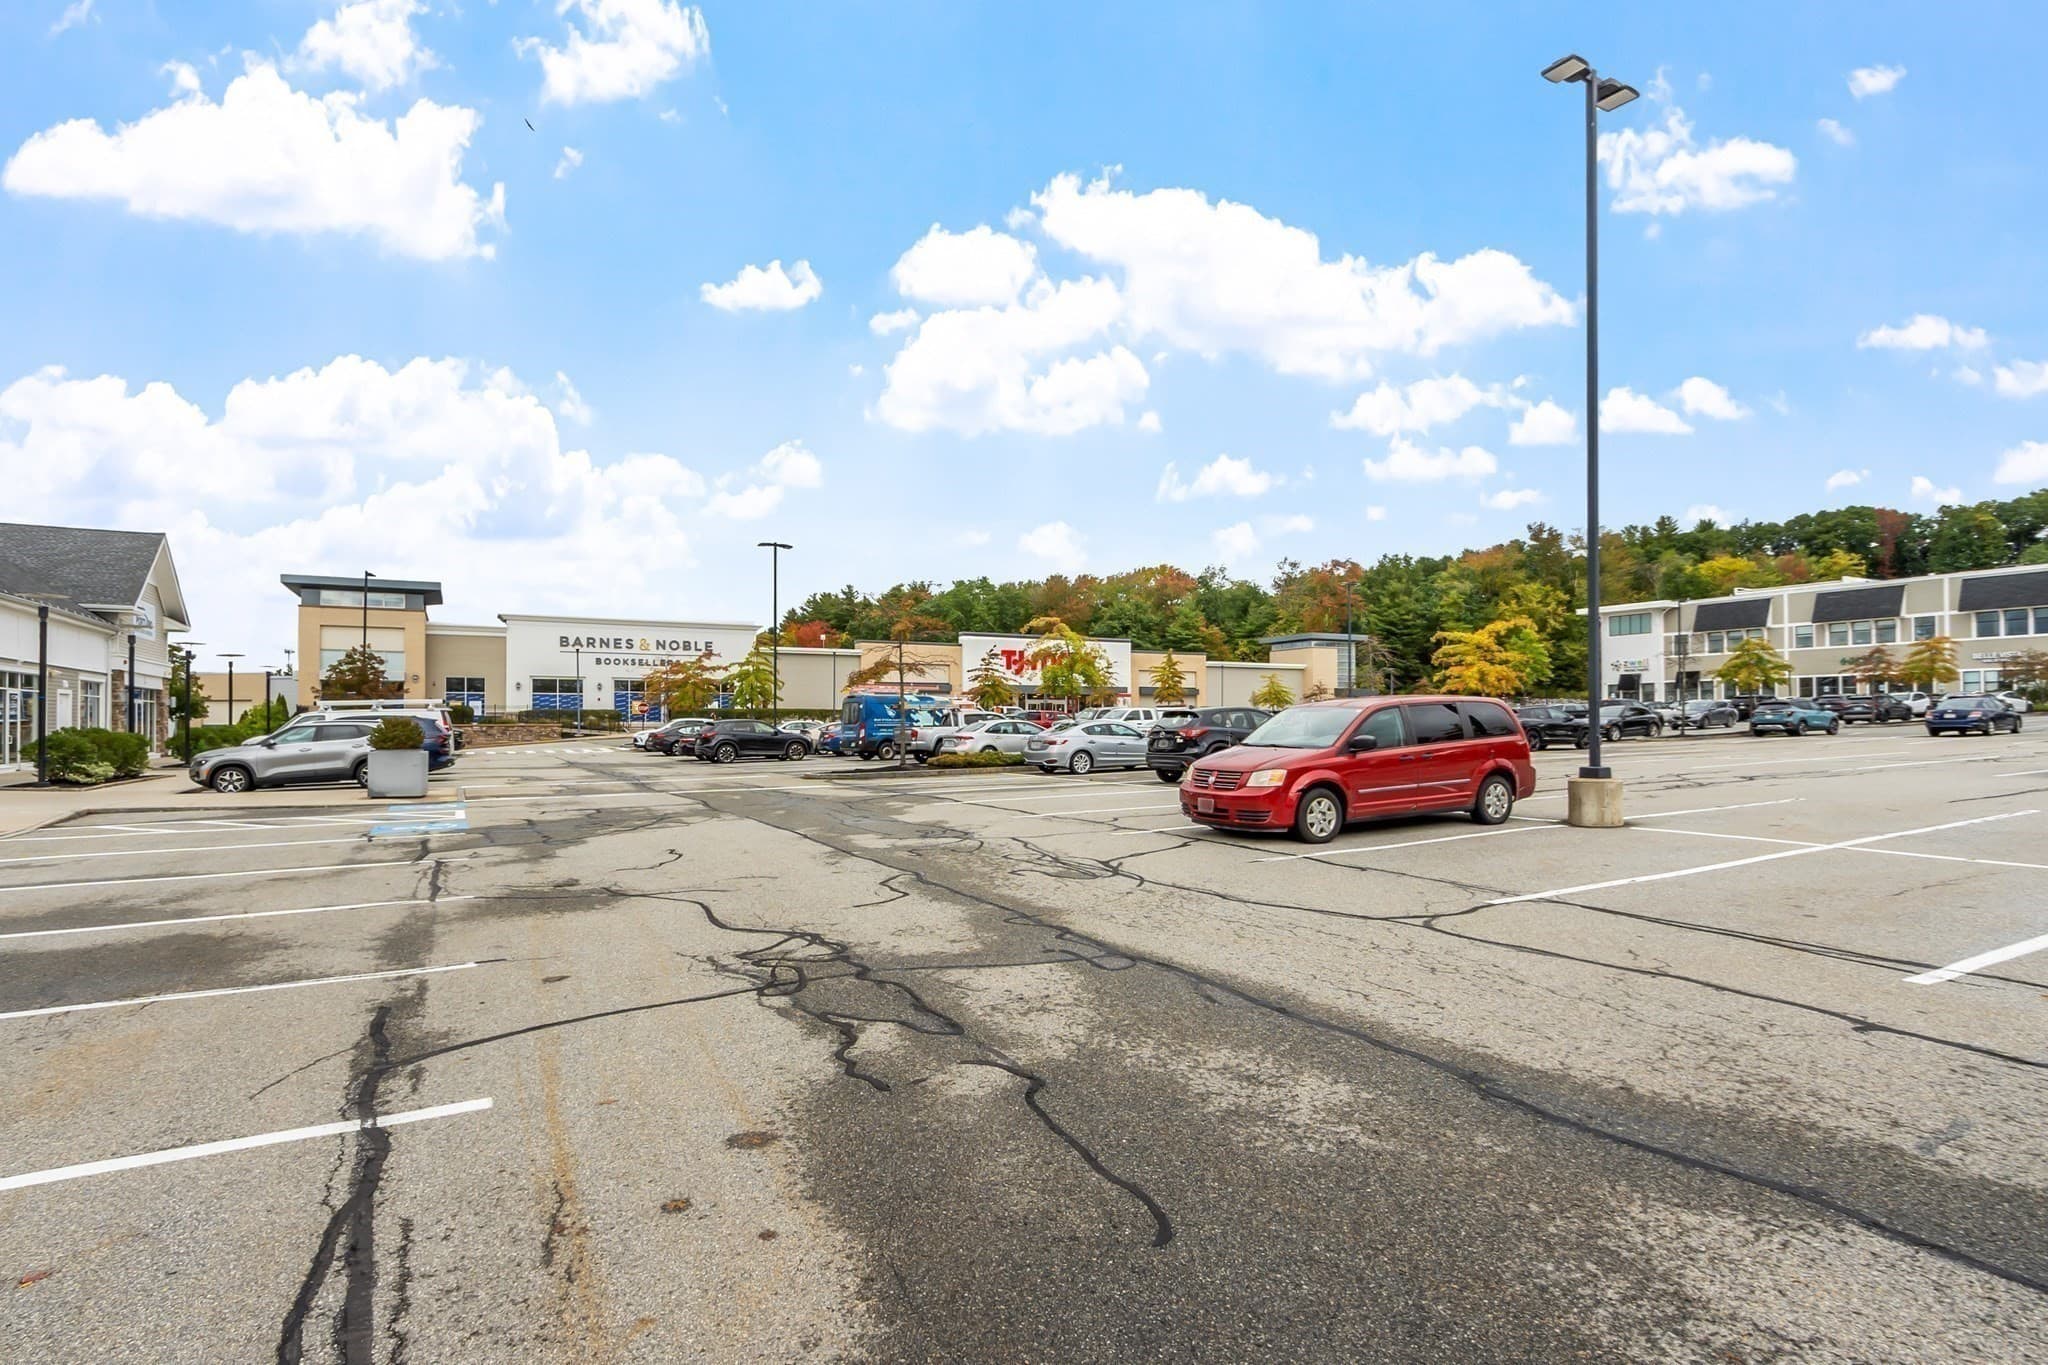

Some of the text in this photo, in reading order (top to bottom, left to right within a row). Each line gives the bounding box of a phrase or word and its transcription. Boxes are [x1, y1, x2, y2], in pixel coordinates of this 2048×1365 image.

[559, 636, 714, 652] BARNES & NOBLE
[595, 657, 681, 667] BOOKSELLER
